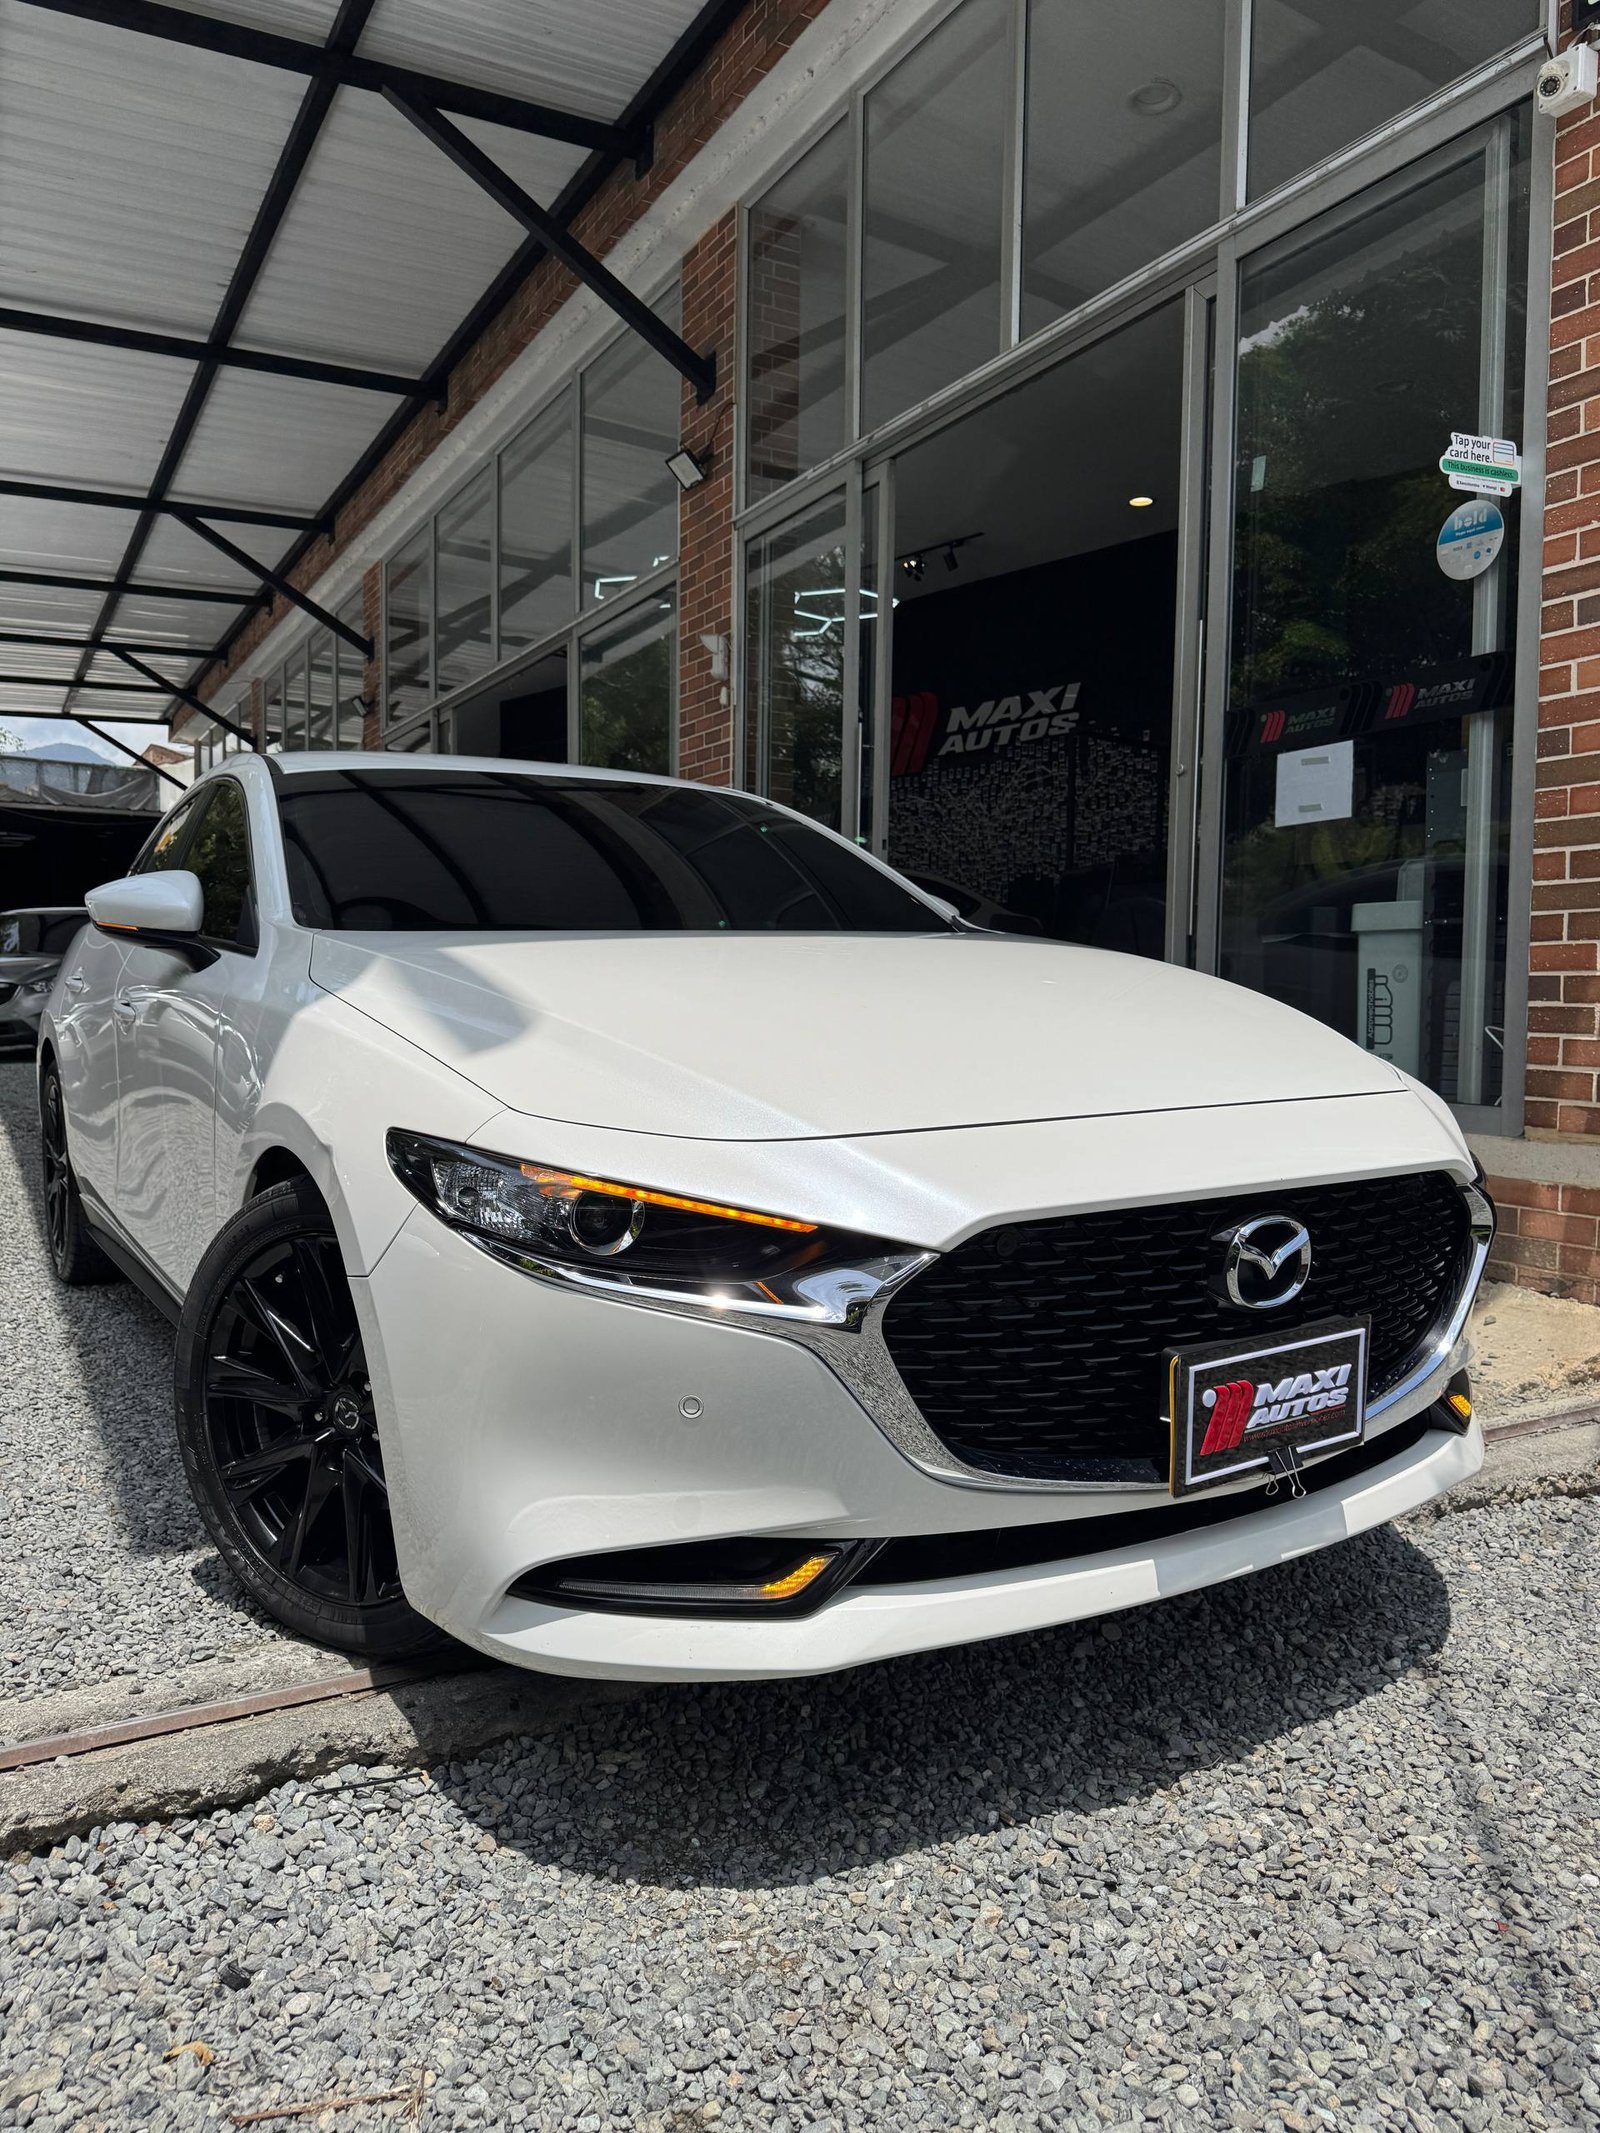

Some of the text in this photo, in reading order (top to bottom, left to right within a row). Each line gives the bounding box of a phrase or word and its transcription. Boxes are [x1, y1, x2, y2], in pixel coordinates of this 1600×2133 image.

[1454, 435, 1490, 450] Tap your
[1450, 447, 1492, 463] card here.
[1448, 461, 1460, 470] This
[1461, 463, 1484, 474] business
[1484, 466, 1490, 474] is
[1454, 508, 1488, 531] bold
[1417, 678, 1476, 699] MAXI
[946, 682, 1081, 732] MAXI
[1414, 689, 1475, 710] AUTOS
[1287, 706, 1336, 724] MAXI
[938, 712, 1080, 755] AUTOS
[1284, 717, 1335, 735] AUTOS
[1253, 1364, 1352, 1407] MAXI
[1246, 1387, 1349, 1429] AUTOS
